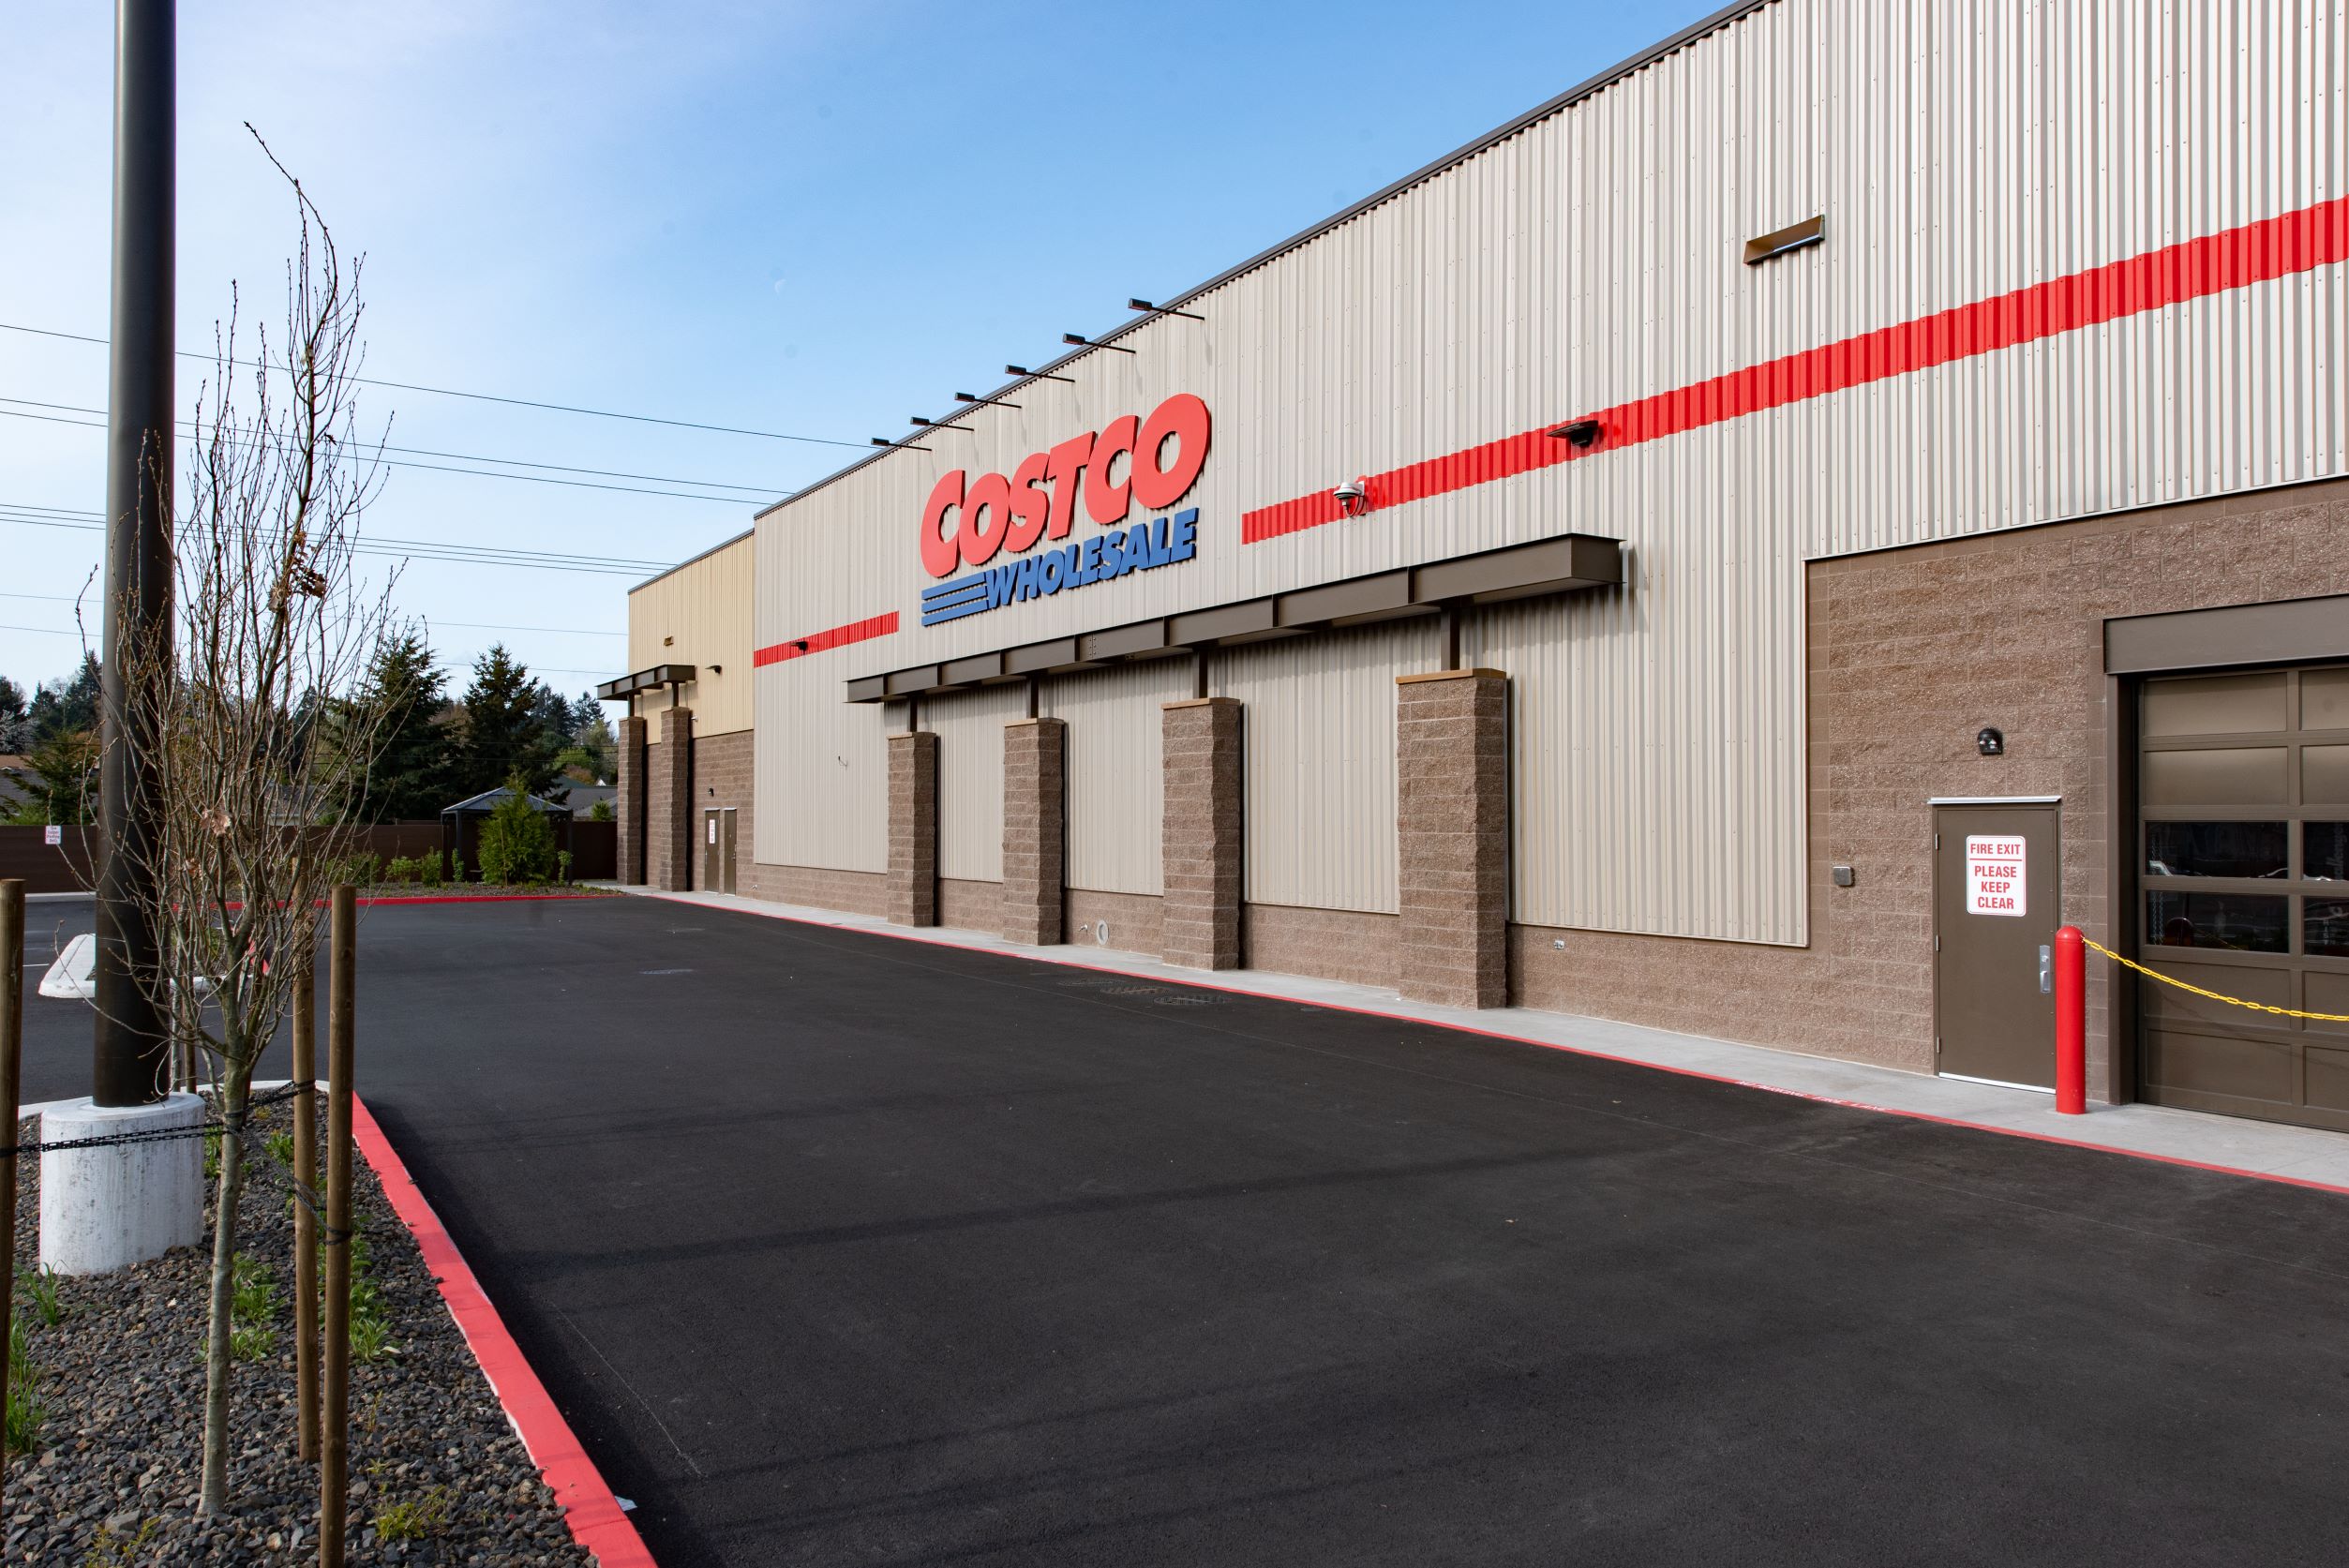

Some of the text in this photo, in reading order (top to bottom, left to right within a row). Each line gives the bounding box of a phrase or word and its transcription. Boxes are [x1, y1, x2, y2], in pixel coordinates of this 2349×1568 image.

[920, 393, 1211, 577] COSTCO
[984, 507, 1199, 609] WHOLESALE
[1970, 844, 2020, 855] FIRE EXIT
[1974, 865, 2016, 877] PLEASE
[1981, 881, 2010, 892] KEEP
[1978, 896, 2013, 909] CLEAR
